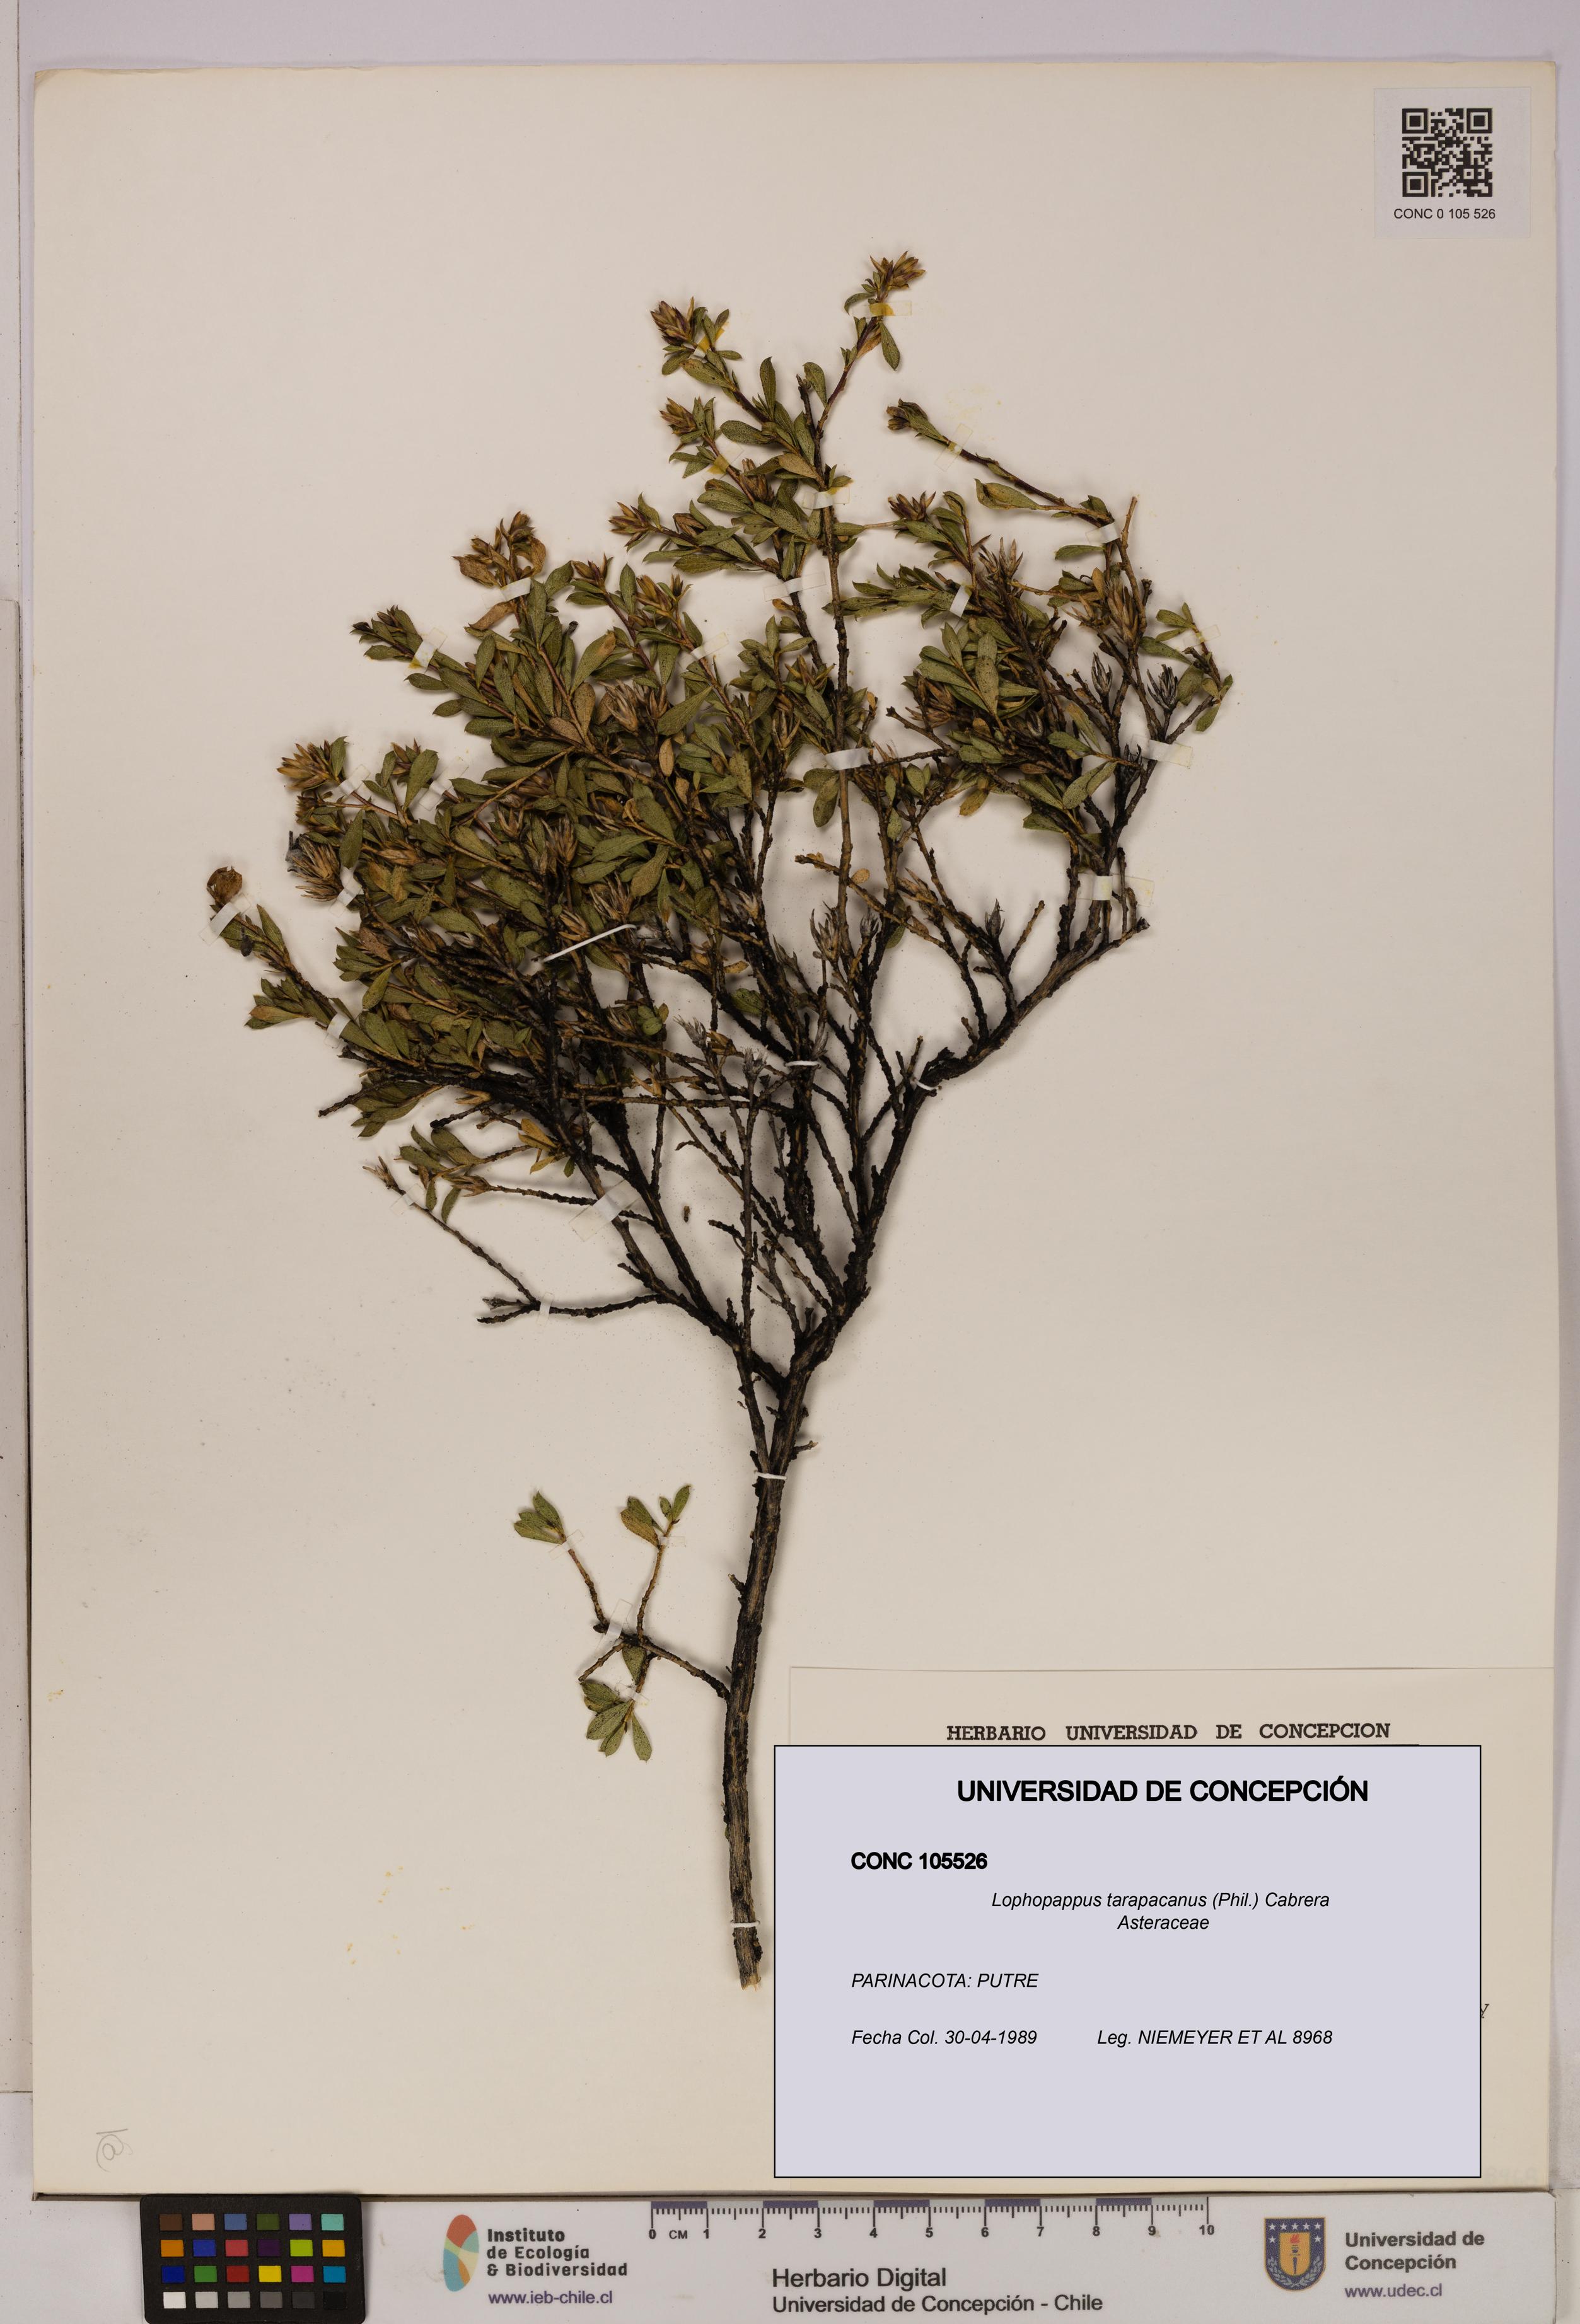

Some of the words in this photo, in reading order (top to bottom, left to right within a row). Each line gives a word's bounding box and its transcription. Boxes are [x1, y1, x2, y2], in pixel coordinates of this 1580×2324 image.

[1393, 208, 1433, 219] CONC
[1436, 208, 1444, 219] 0
[1449, 208, 1470, 219] 105
[1473, 208, 1496, 219] 526
[946, 1725, 1046, 1741] HERBARIO
[1065, 1724, 1198, 1741] UNIVERSIDAD
[1216, 1724, 1242, 1740] DE
[1259, 1723, 1391, 1739] CONCEPCION
[487, 2227, 566, 2242] Instituto
[648, 2228, 658, 2240] 0
[668, 2229, 688, 2240] CM
[702, 2228, 710, 2240] 1
[757, 2228, 767, 2239] 2
[813, 2228, 823, 2239] 3
[868, 2227, 879, 2238] 4
[924, 2227, 934, 2238] 5
[980, 2226, 990, 2238] 6
[1036, 2226, 1045, 2237] 7
[1091, 2226, 1101, 2237] 8
[1147, 2225, 1157, 2236] 9
[1198, 2224, 1216, 2236] 10
[1345, 2231, 1456, 2248] Universidad
[1462, 2231, 1485, 2246] de
[486, 2245, 508, 2260] de
[514, 2245, 590, 2262] Ecología
[487, 2263, 499, 2277] &
[506, 2262, 627, 2277] Biodiversidad
[1345, 2254, 1456, 2274] Concepción
[772, 2268, 869, 2288] Herbario
[877, 2267, 946, 2292] Digital
[488, 2290, 613, 2304] www.ieb-chile.cl
[1344, 2283, 1443, 2298] www.udec.cl
[773, 2296, 885, 2313] Universidad
[891, 2296, 915, 2312] de
[921, 2294, 1035, 2316] Concepción
[1054, 2294, 1103, 2311] Chile
